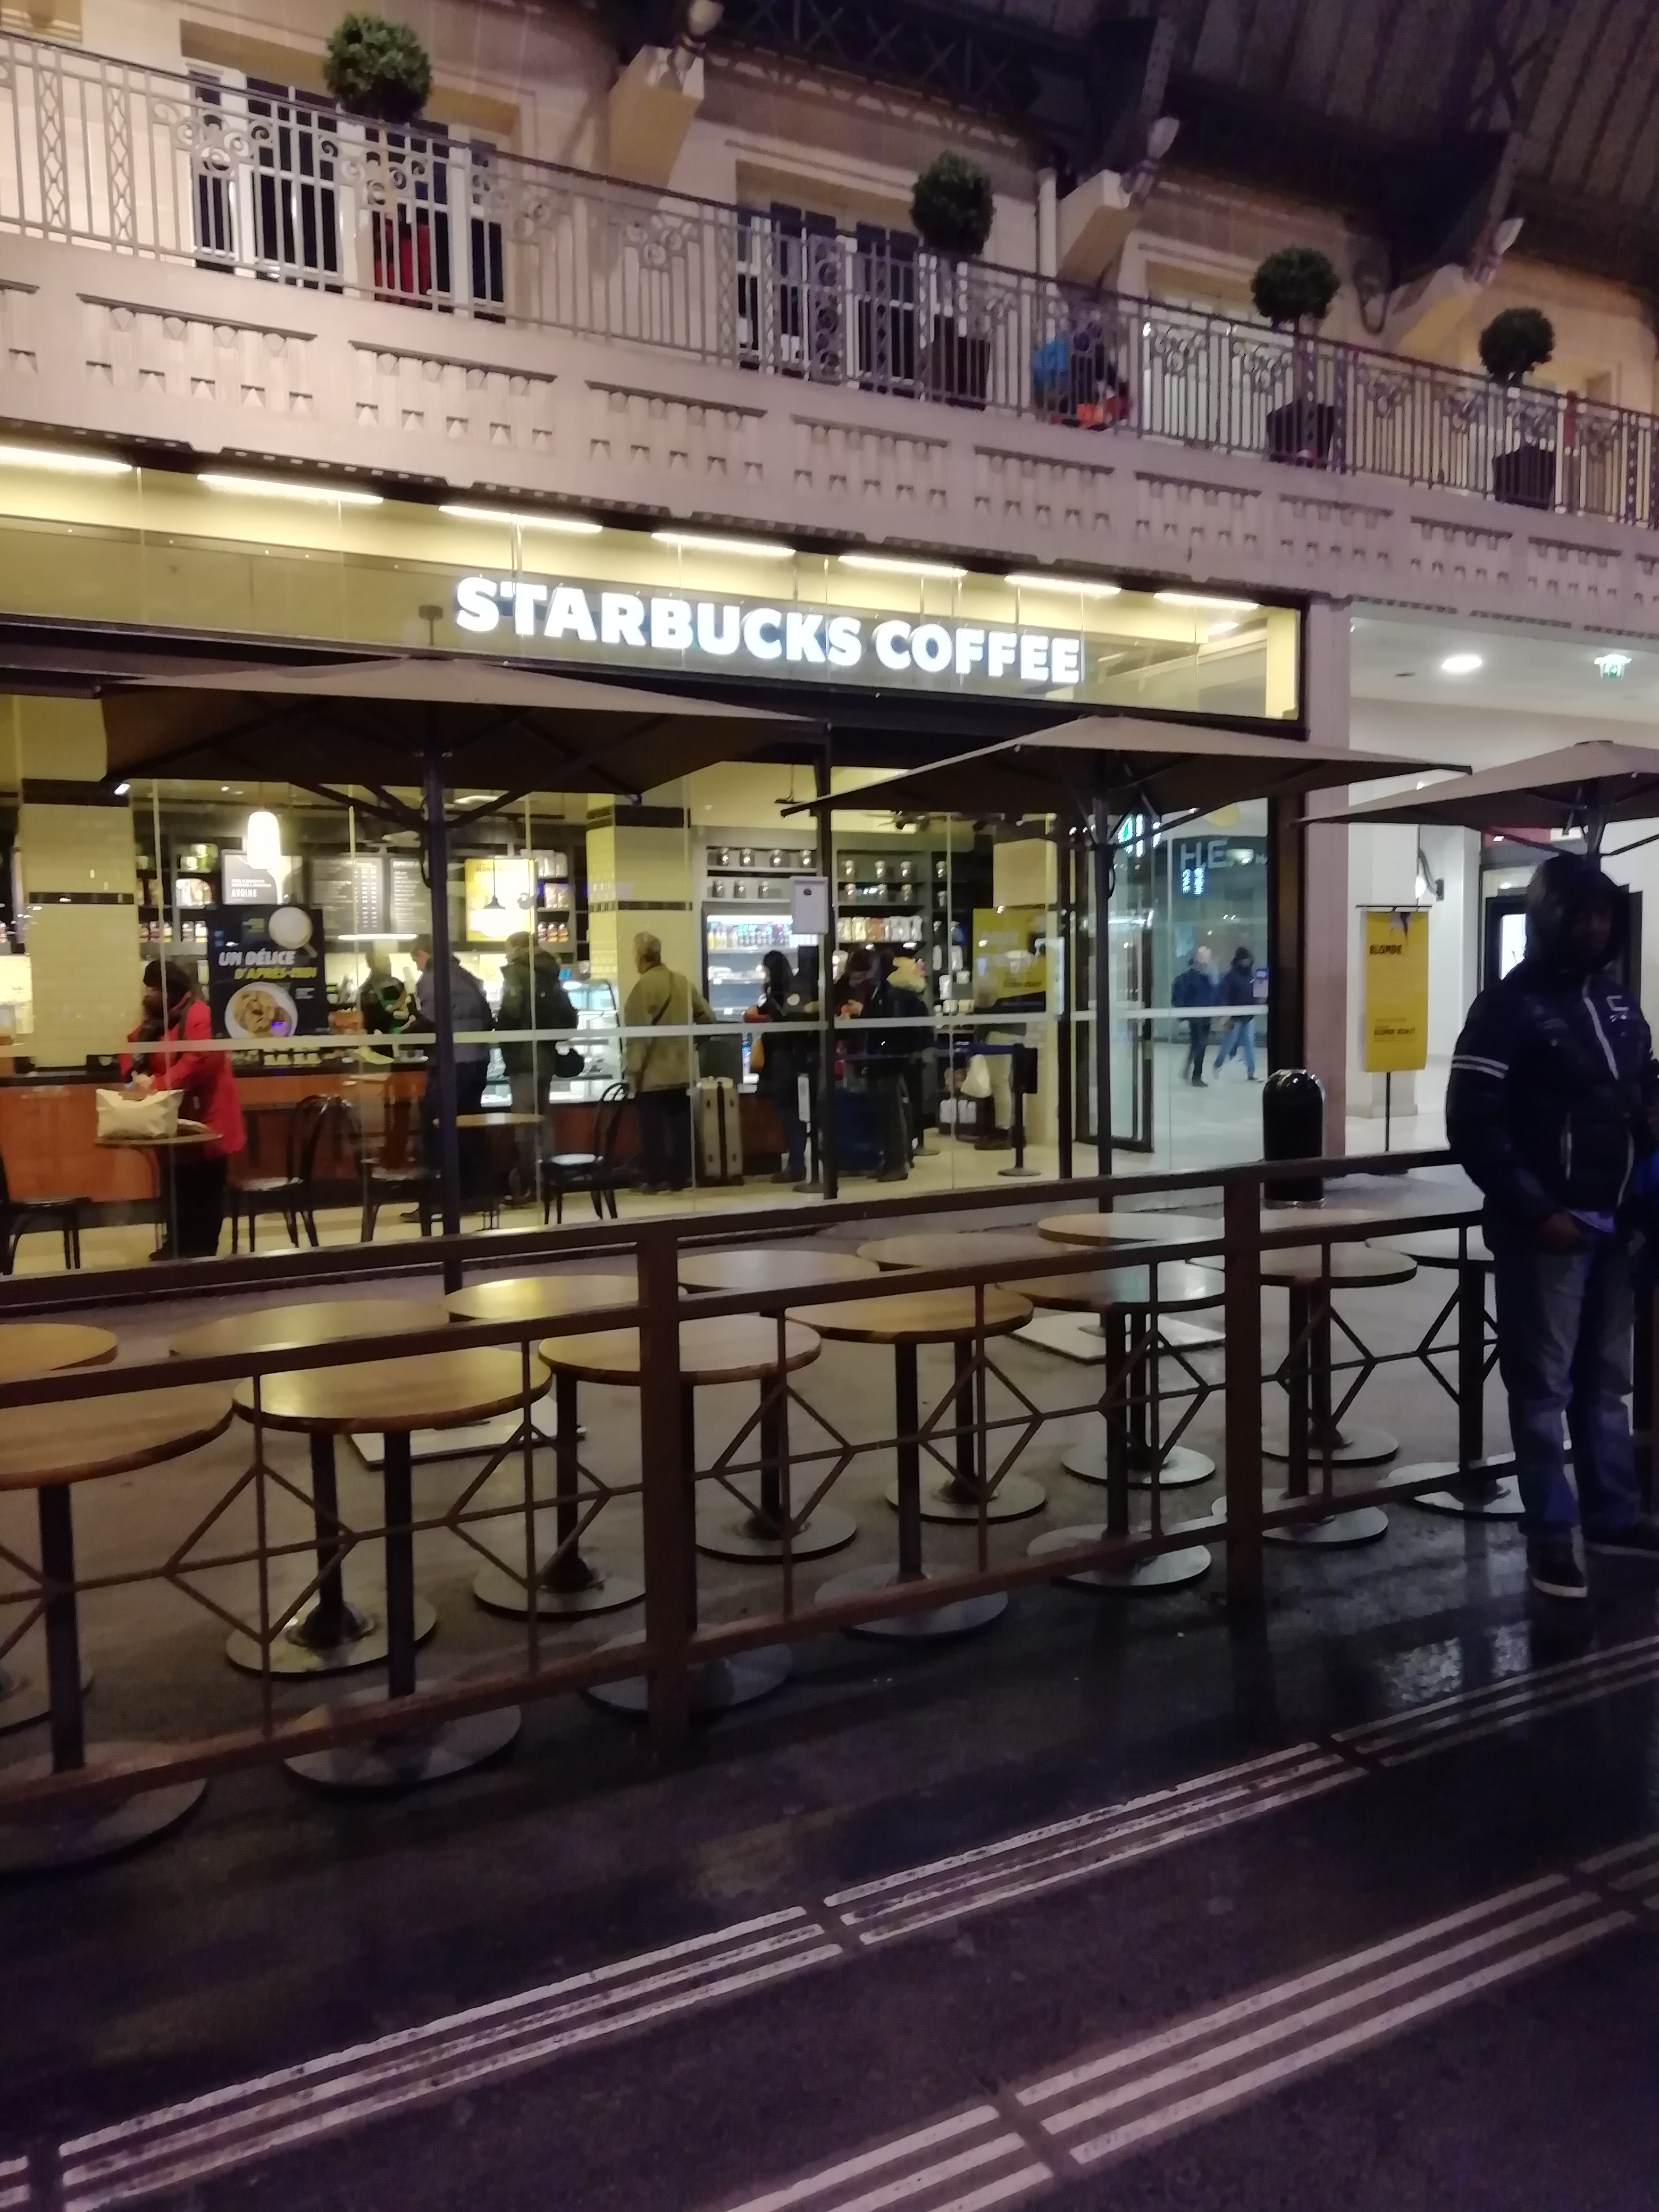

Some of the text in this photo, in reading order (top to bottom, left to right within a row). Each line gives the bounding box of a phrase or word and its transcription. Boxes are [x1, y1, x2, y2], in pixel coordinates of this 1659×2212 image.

[456, 576, 1080, 683] STARBUCKS COFFEE
[231, 888, 257, 898] AVOINE
[219, 948, 296, 967] UN DÉLICE
